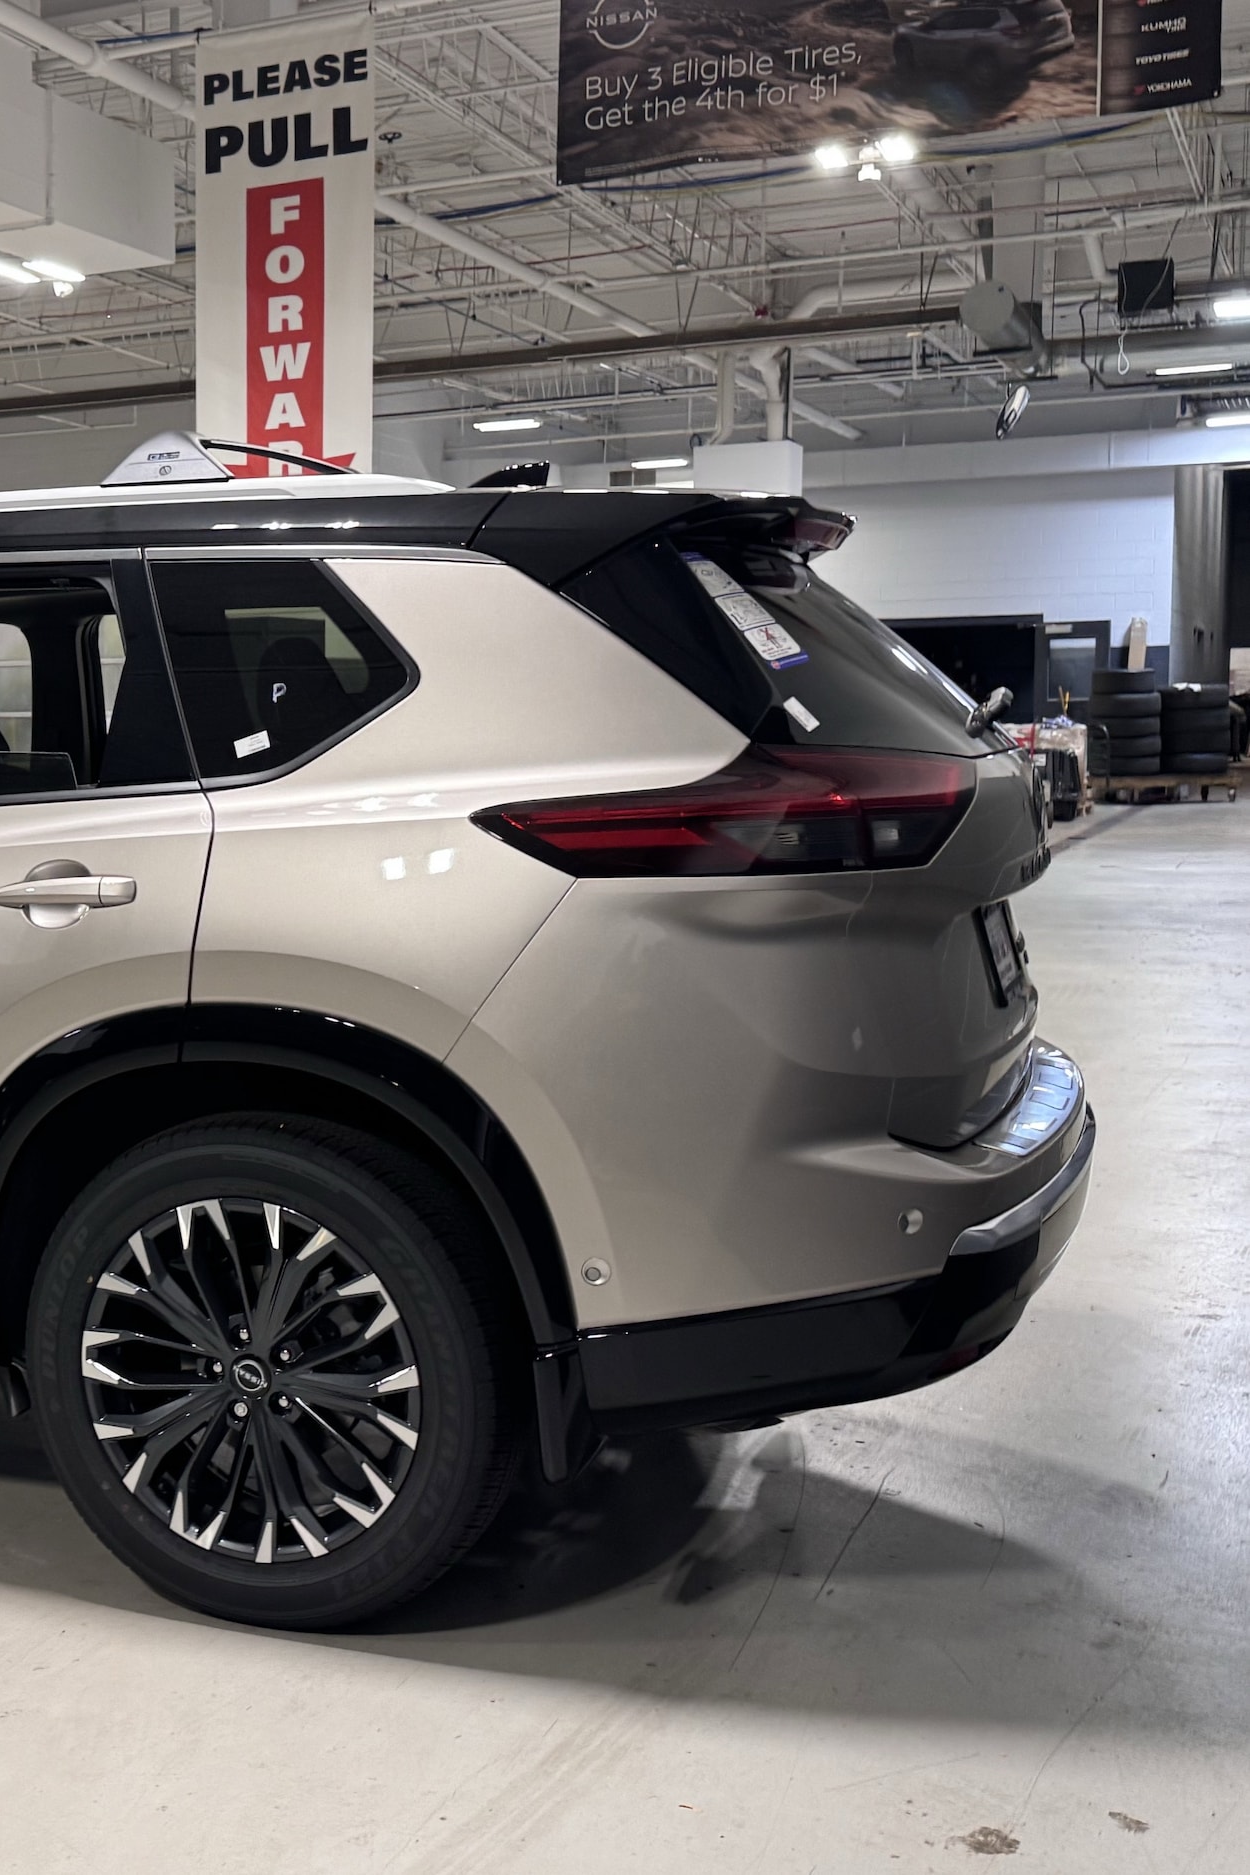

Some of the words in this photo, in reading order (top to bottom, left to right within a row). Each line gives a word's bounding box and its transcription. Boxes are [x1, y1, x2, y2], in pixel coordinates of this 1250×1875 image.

[585, 7, 658, 29] NISSAN
[203, 48, 368, 106] PLEASE
[585, 74, 638, 100] Buy
[647, 67, 663, 91] 3
[672, 51, 774, 86] Eligible
[784, 42, 862, 73] Tires,
[1147, 78, 1192, 94] YOKOHAMA
[584, 103, 634, 130] Get
[642, 95, 686, 122] the
[695, 85, 744, 111] 4th
[756, 81, 799, 107] for
[205, 106, 368, 175] PULL
[260, 194, 312, 477] FORWAR
[272, 682, 287, 703] P
[40, 1225, 89, 1380] DUNLOP
